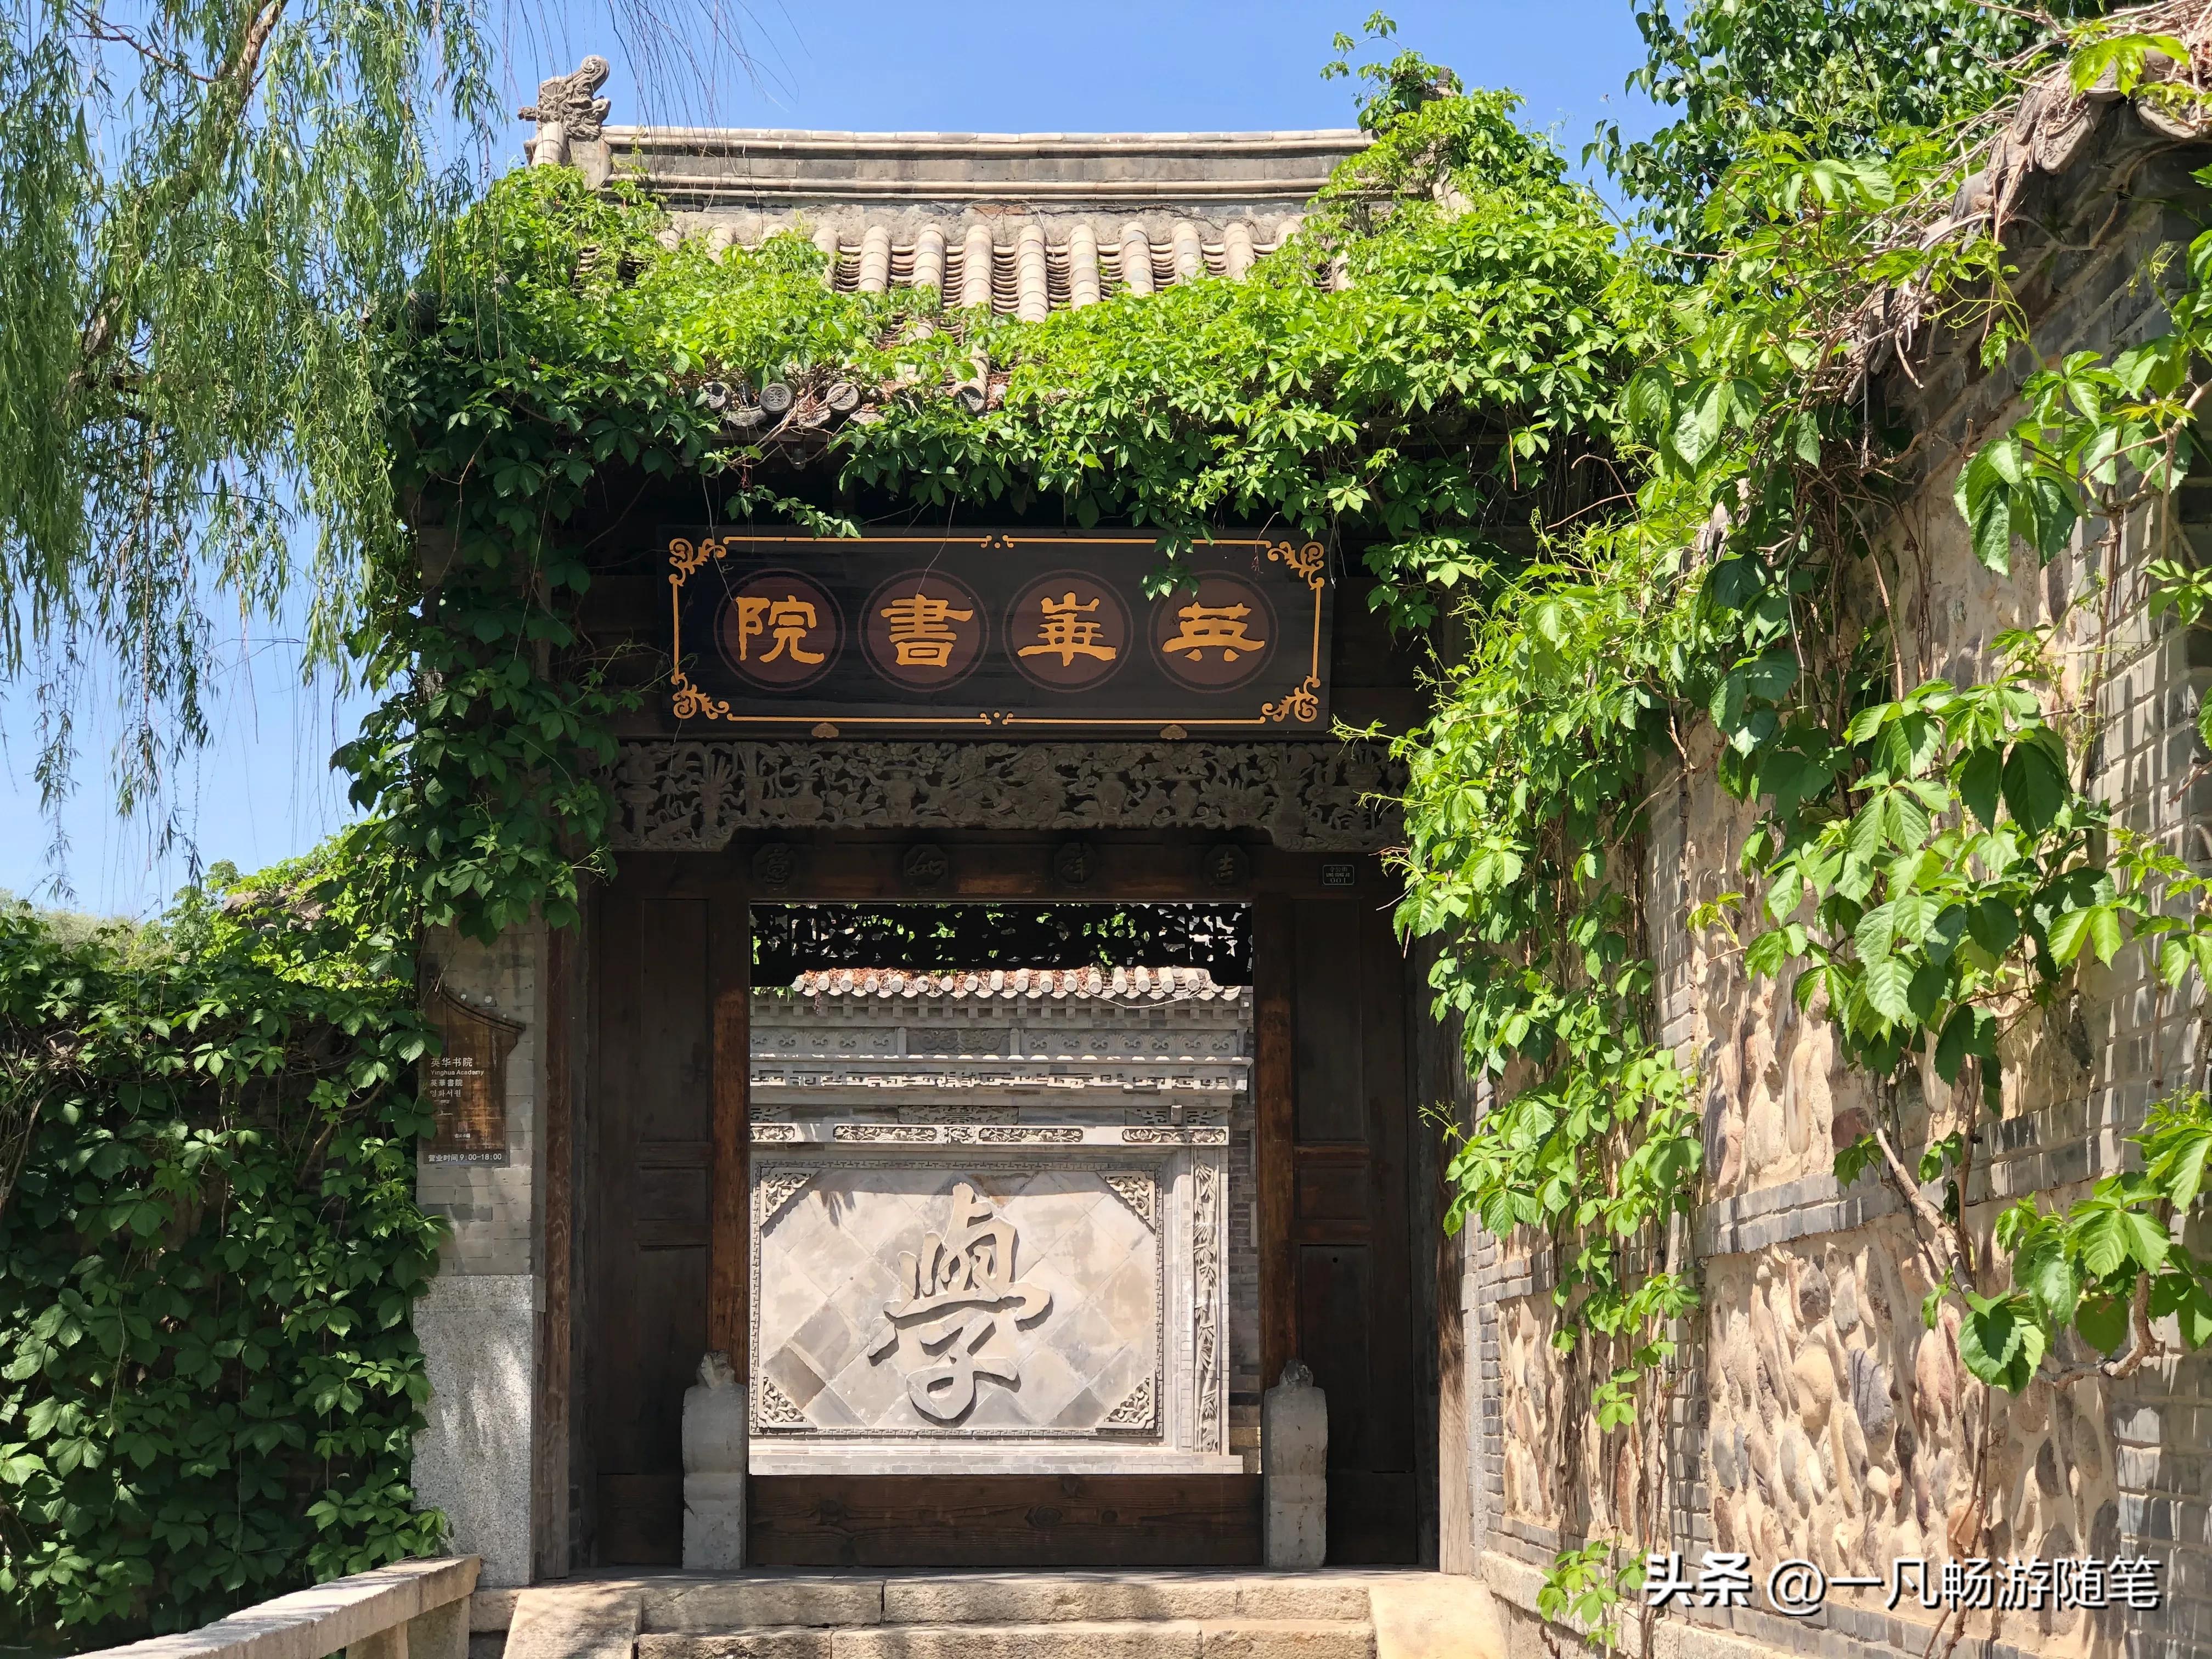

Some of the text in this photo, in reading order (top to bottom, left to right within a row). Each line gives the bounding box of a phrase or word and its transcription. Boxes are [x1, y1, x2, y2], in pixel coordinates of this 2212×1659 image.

[430, 1057, 473, 1067] 英华书院
[430, 1079, 463, 1087] 英華書院
[428, 1154, 458, 1162] 营业时间
